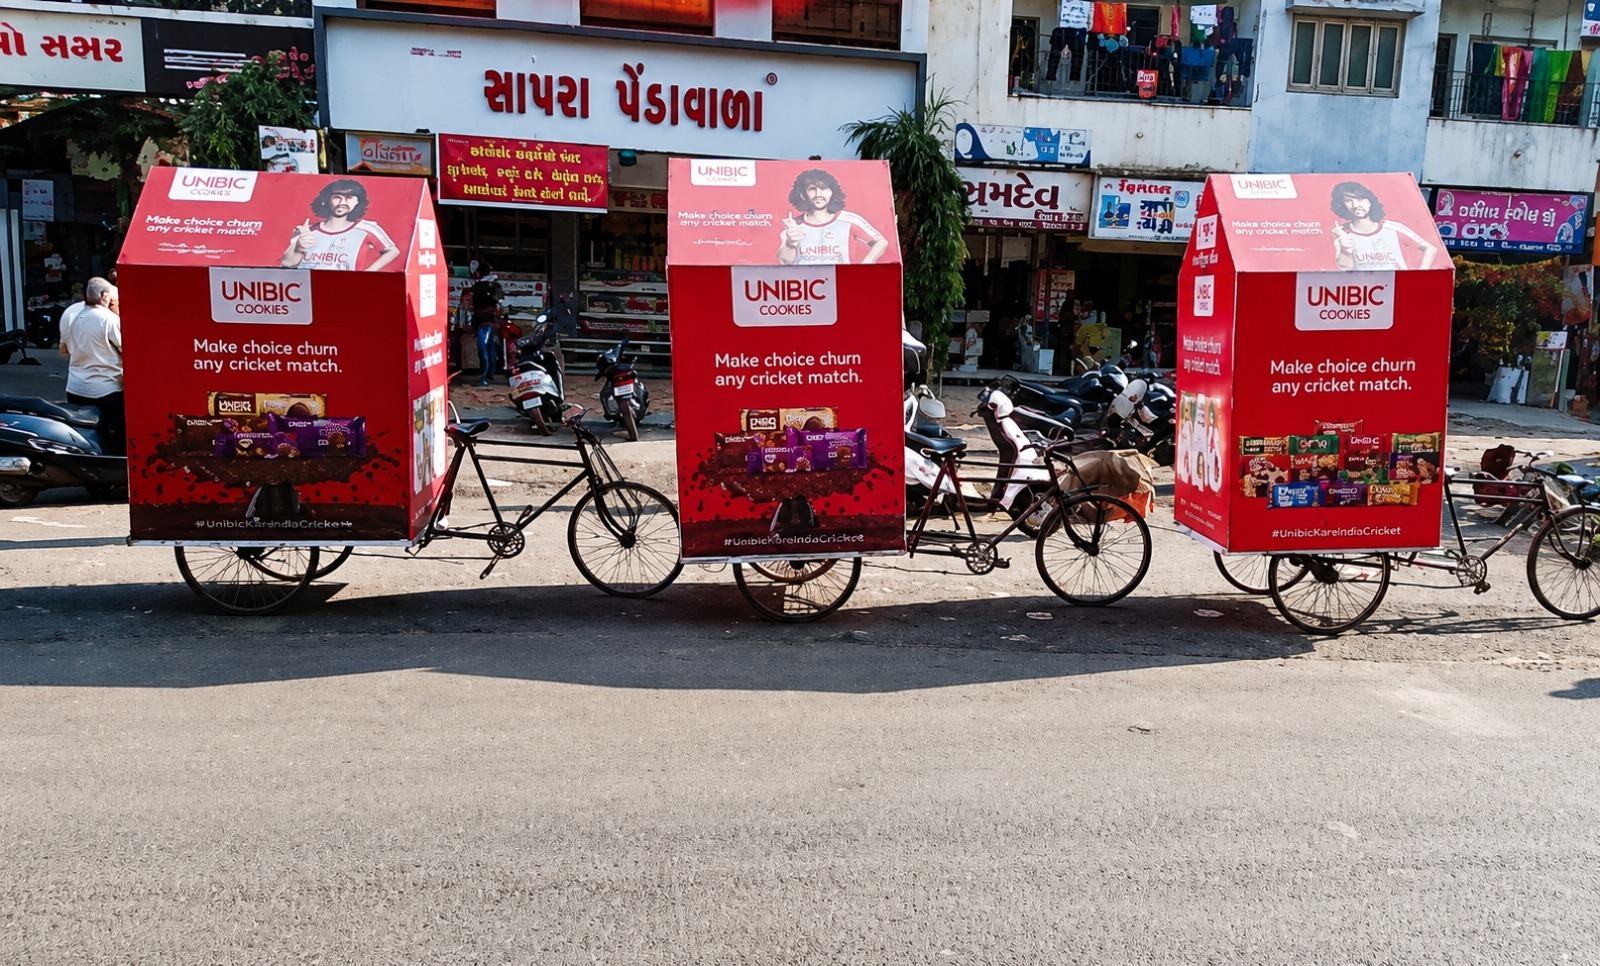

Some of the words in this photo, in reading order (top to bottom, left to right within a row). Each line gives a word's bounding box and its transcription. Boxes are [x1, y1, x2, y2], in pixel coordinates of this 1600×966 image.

[484, 69, 590, 118] સાપરા
[616, 62, 763, 132] પેંડાવાળા
[698, 166, 748, 177] UNIBIC
[182, 175, 249, 189] UNIBIC
[1237, 180, 1287, 190] UNIBIC
[146, 215, 181, 225] Make
[184, 217, 223, 226] choice
[146, 226, 171, 234] any
[173, 225, 214, 235] cricket
[303, 251, 348, 264] UNIBIC
[221, 280, 301, 303] UNIBIC
[744, 278, 826, 302] UNIBIC
[1307, 285, 1385, 307] UNIBIC
[234, 303, 289, 315] COOKIES
[759, 304, 812, 315] COOKIES
[1319, 309, 1371, 320] COOKIES
[193, 338, 238, 354] Make
[243, 340, 294, 355] choice
[297, 342, 338, 356] churn
[193, 360, 224, 374] any
[229, 357, 284, 372] cricket
[287, 359, 343, 374] match.
[715, 352, 759, 368] Make
[764, 351, 815, 367] choice
[819, 350, 862, 366] churn
[1270, 360, 1314, 375] Make
[1317, 358, 1367, 374] choice
[1371, 357, 1416, 372] churn
[715, 374, 746, 389] any
[750, 371, 803, 385] cricket
[808, 369, 863, 384] match.
[1271, 381, 1301, 397] any
[1304, 378, 1356, 393] cricket
[1359, 376, 1412, 391] match.
